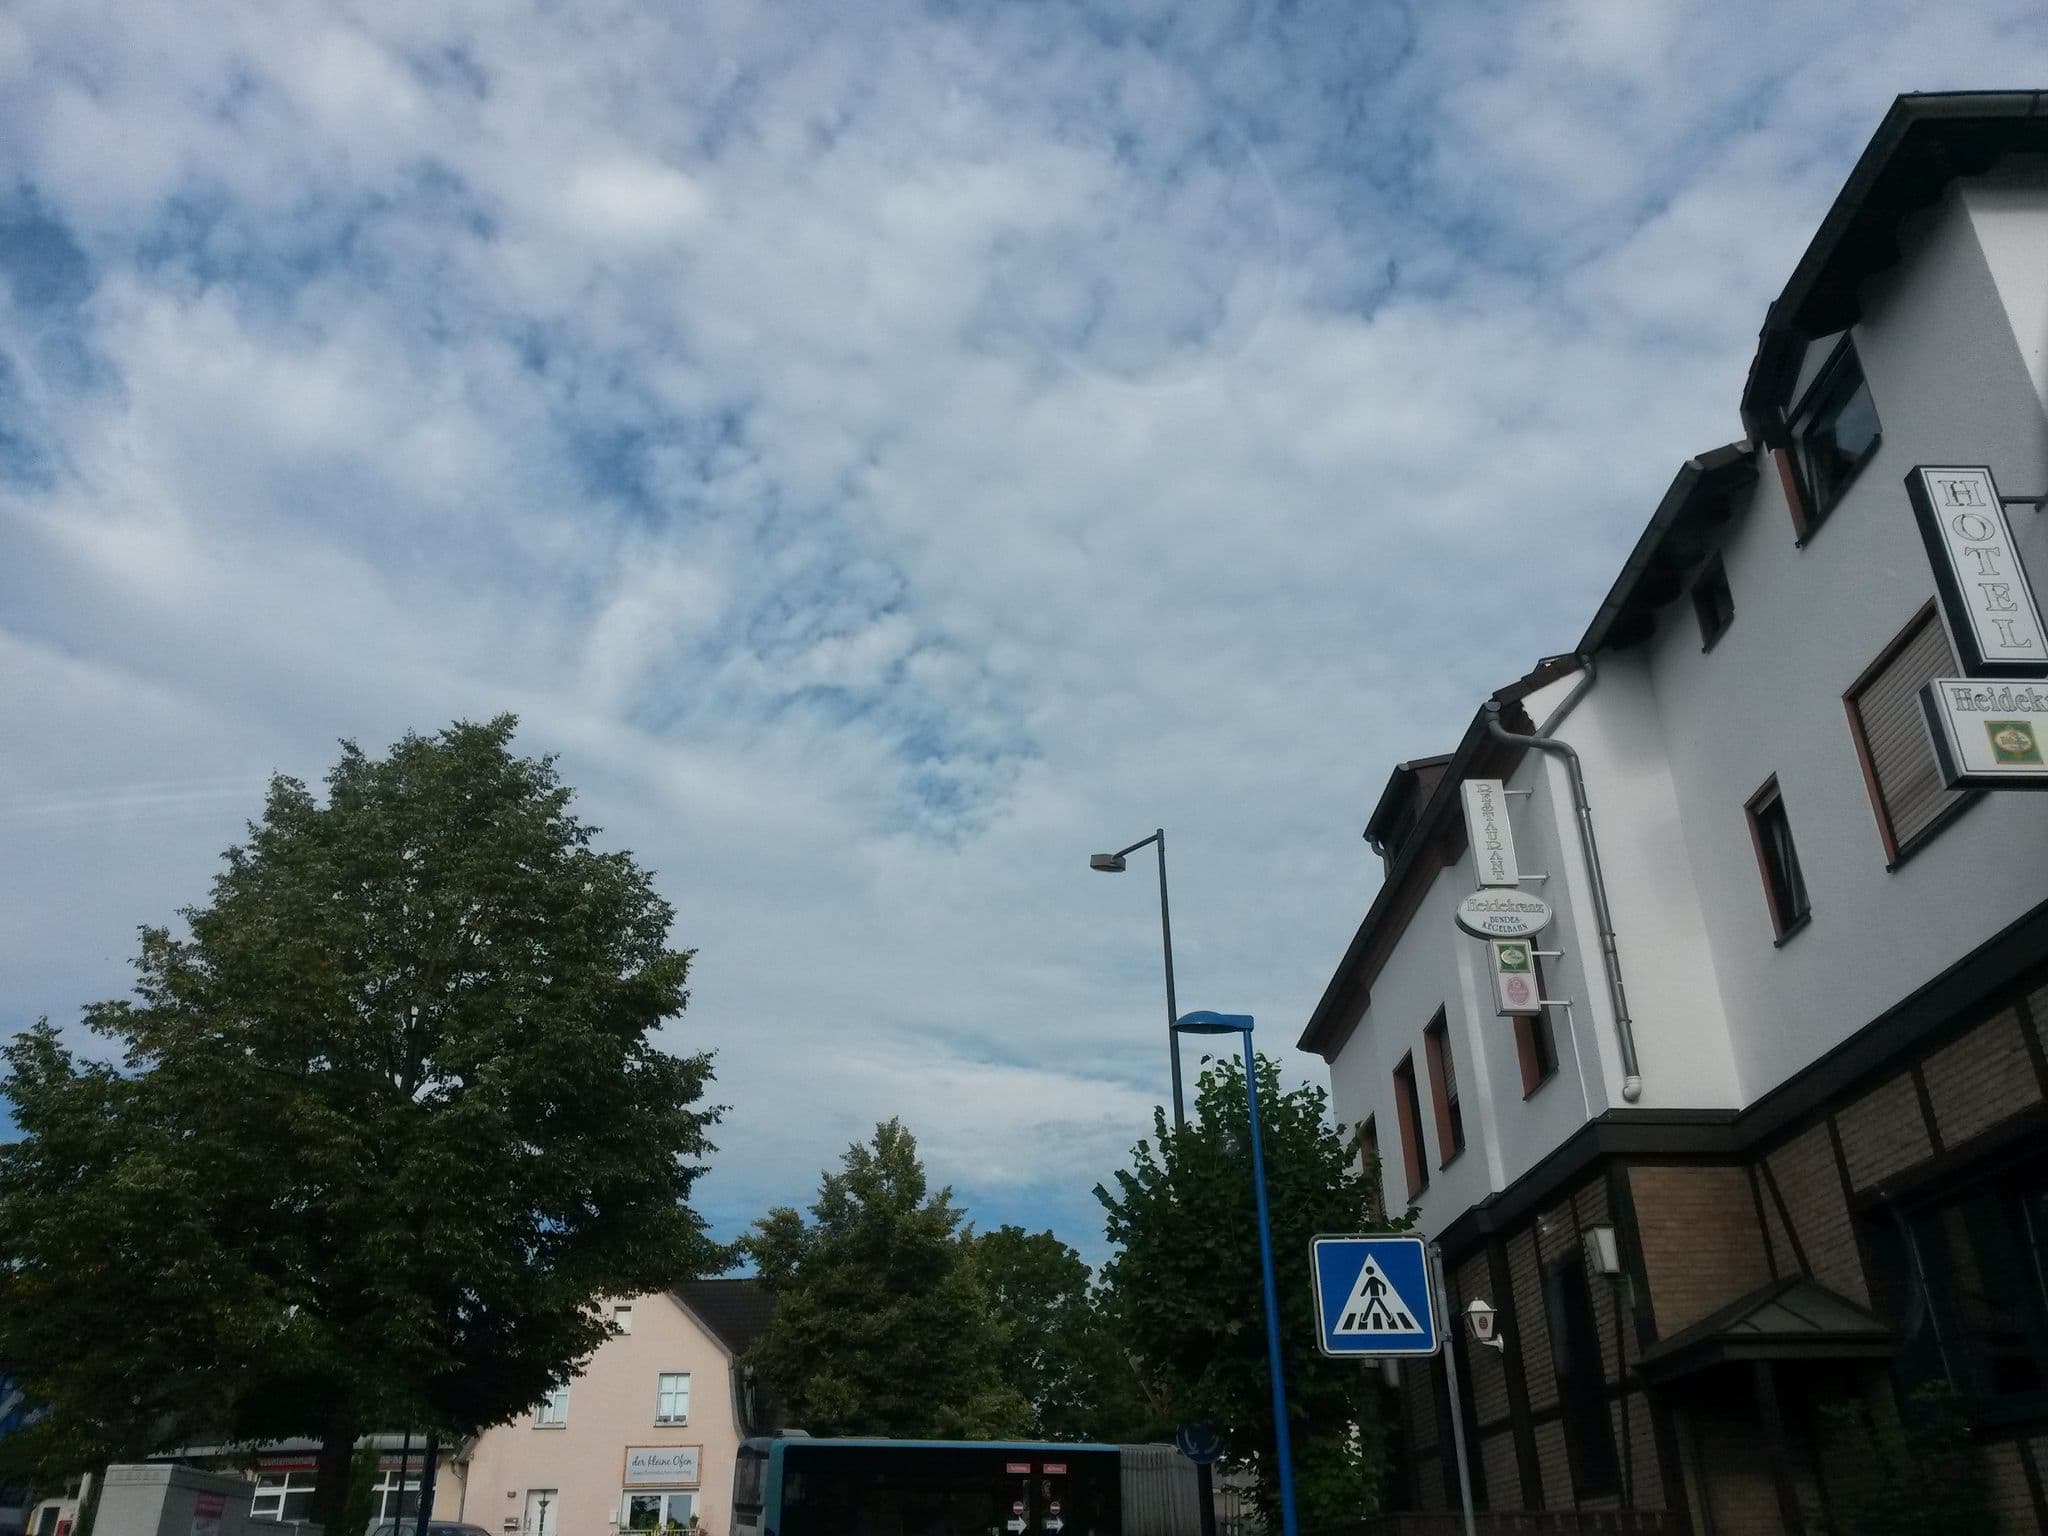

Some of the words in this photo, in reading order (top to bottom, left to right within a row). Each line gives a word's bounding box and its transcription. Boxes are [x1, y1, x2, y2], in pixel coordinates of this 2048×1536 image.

[1937, 480, 2032, 648] HOTEL
[1950, 686, 2048, 712] Heidek
[1476, 783, 1504, 880] RESTAURANT
[631, 1455, 645, 1466] der
[648, 1455, 671, 1467] kleine
[672, 1453, 692, 1468] Ofen
